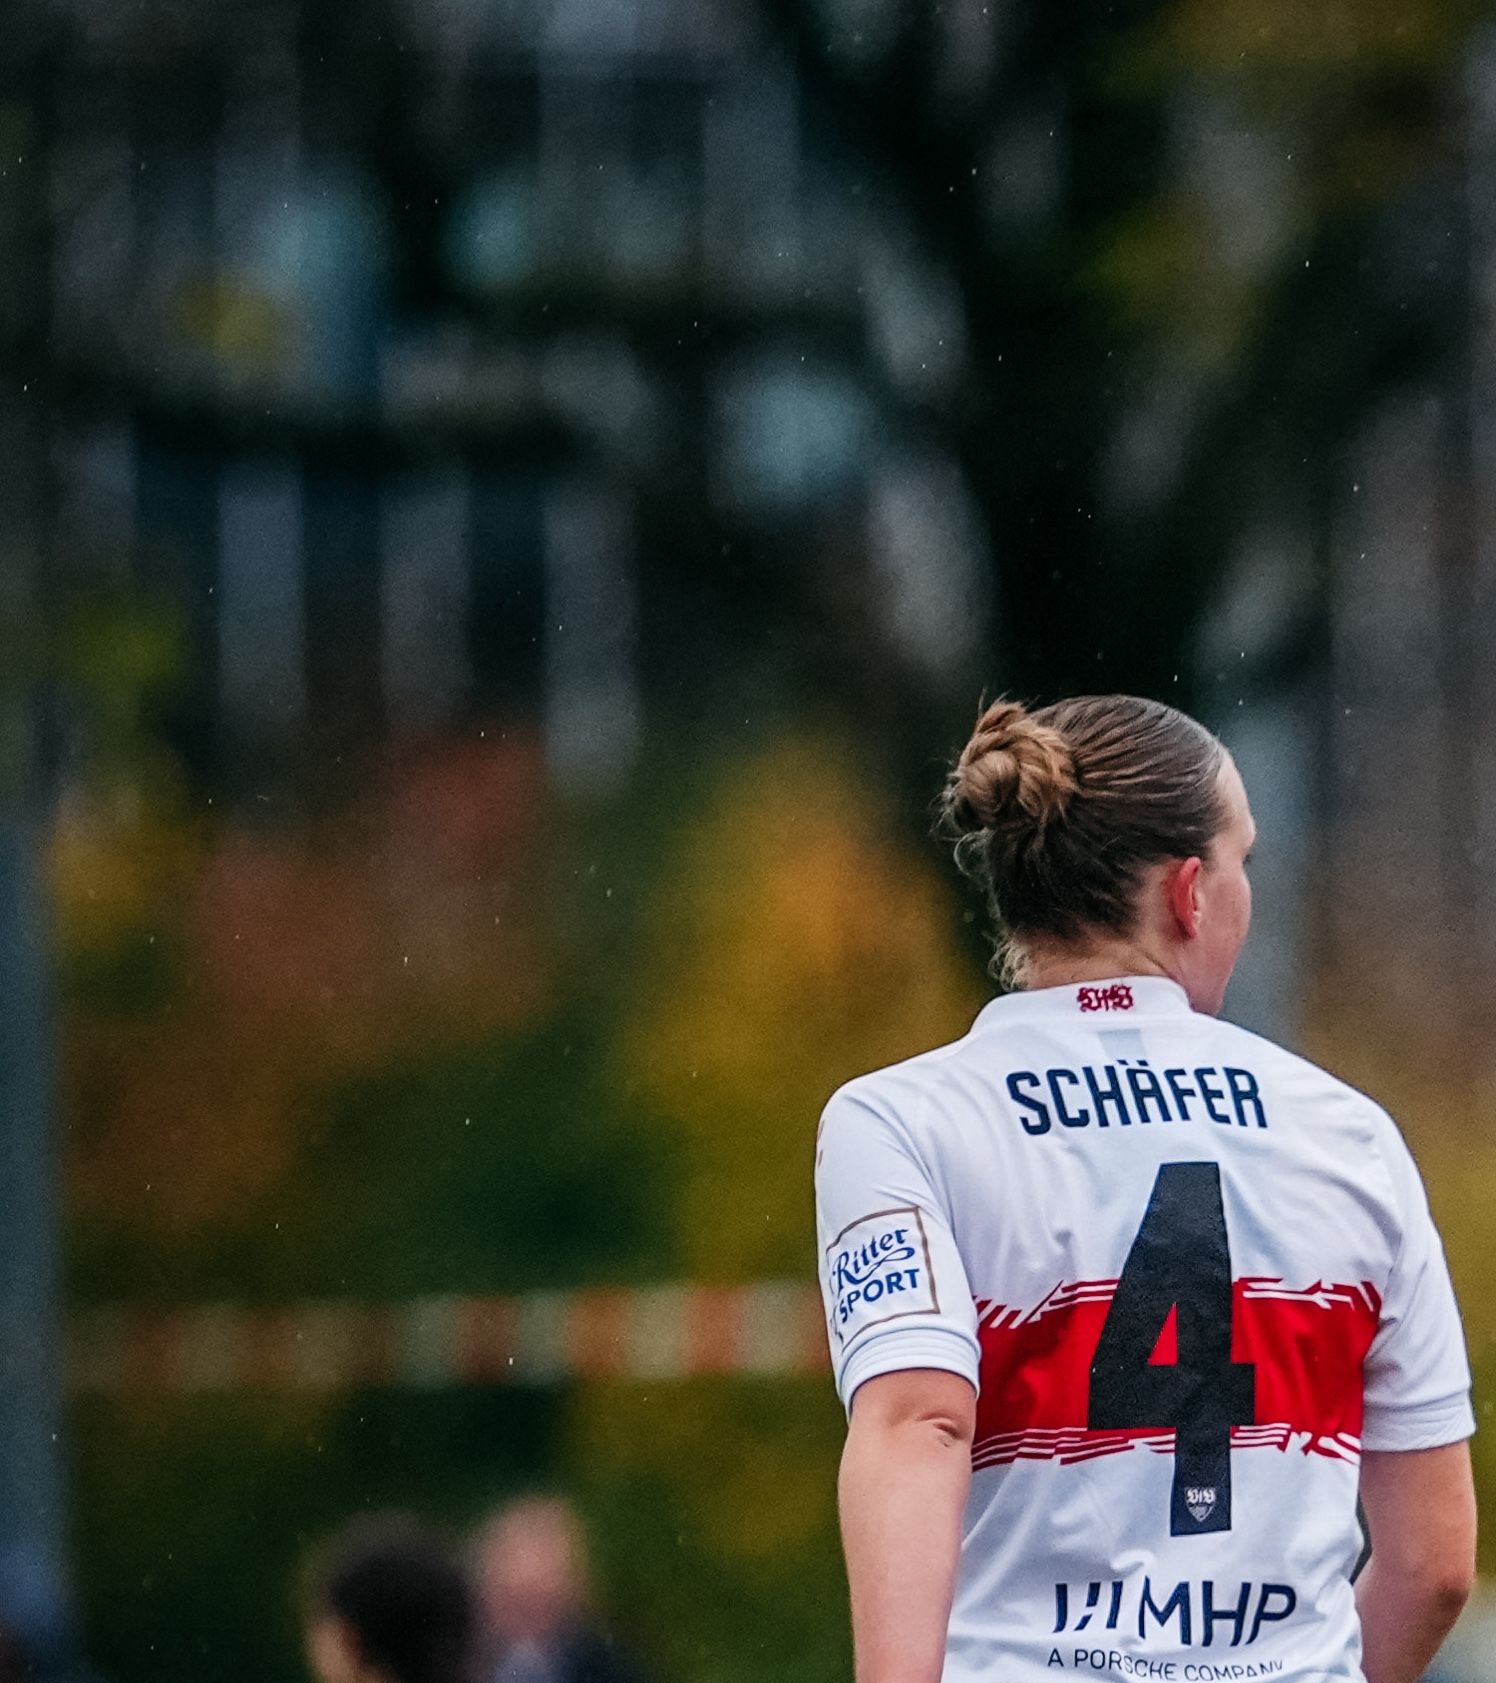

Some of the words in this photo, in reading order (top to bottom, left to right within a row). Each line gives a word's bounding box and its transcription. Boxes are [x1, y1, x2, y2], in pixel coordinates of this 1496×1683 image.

[1004, 1058, 1268, 1137] SCHÄFER
[832, 1228, 915, 1296] Ritter
[838, 1268, 921, 1324] SPORT
[1086, 1161, 1256, 1537] 4
[1137, 1575, 1298, 1648] MHP
[1047, 1648, 1064, 1667] A
[1073, 1649, 1178, 1681] PORSCHE
